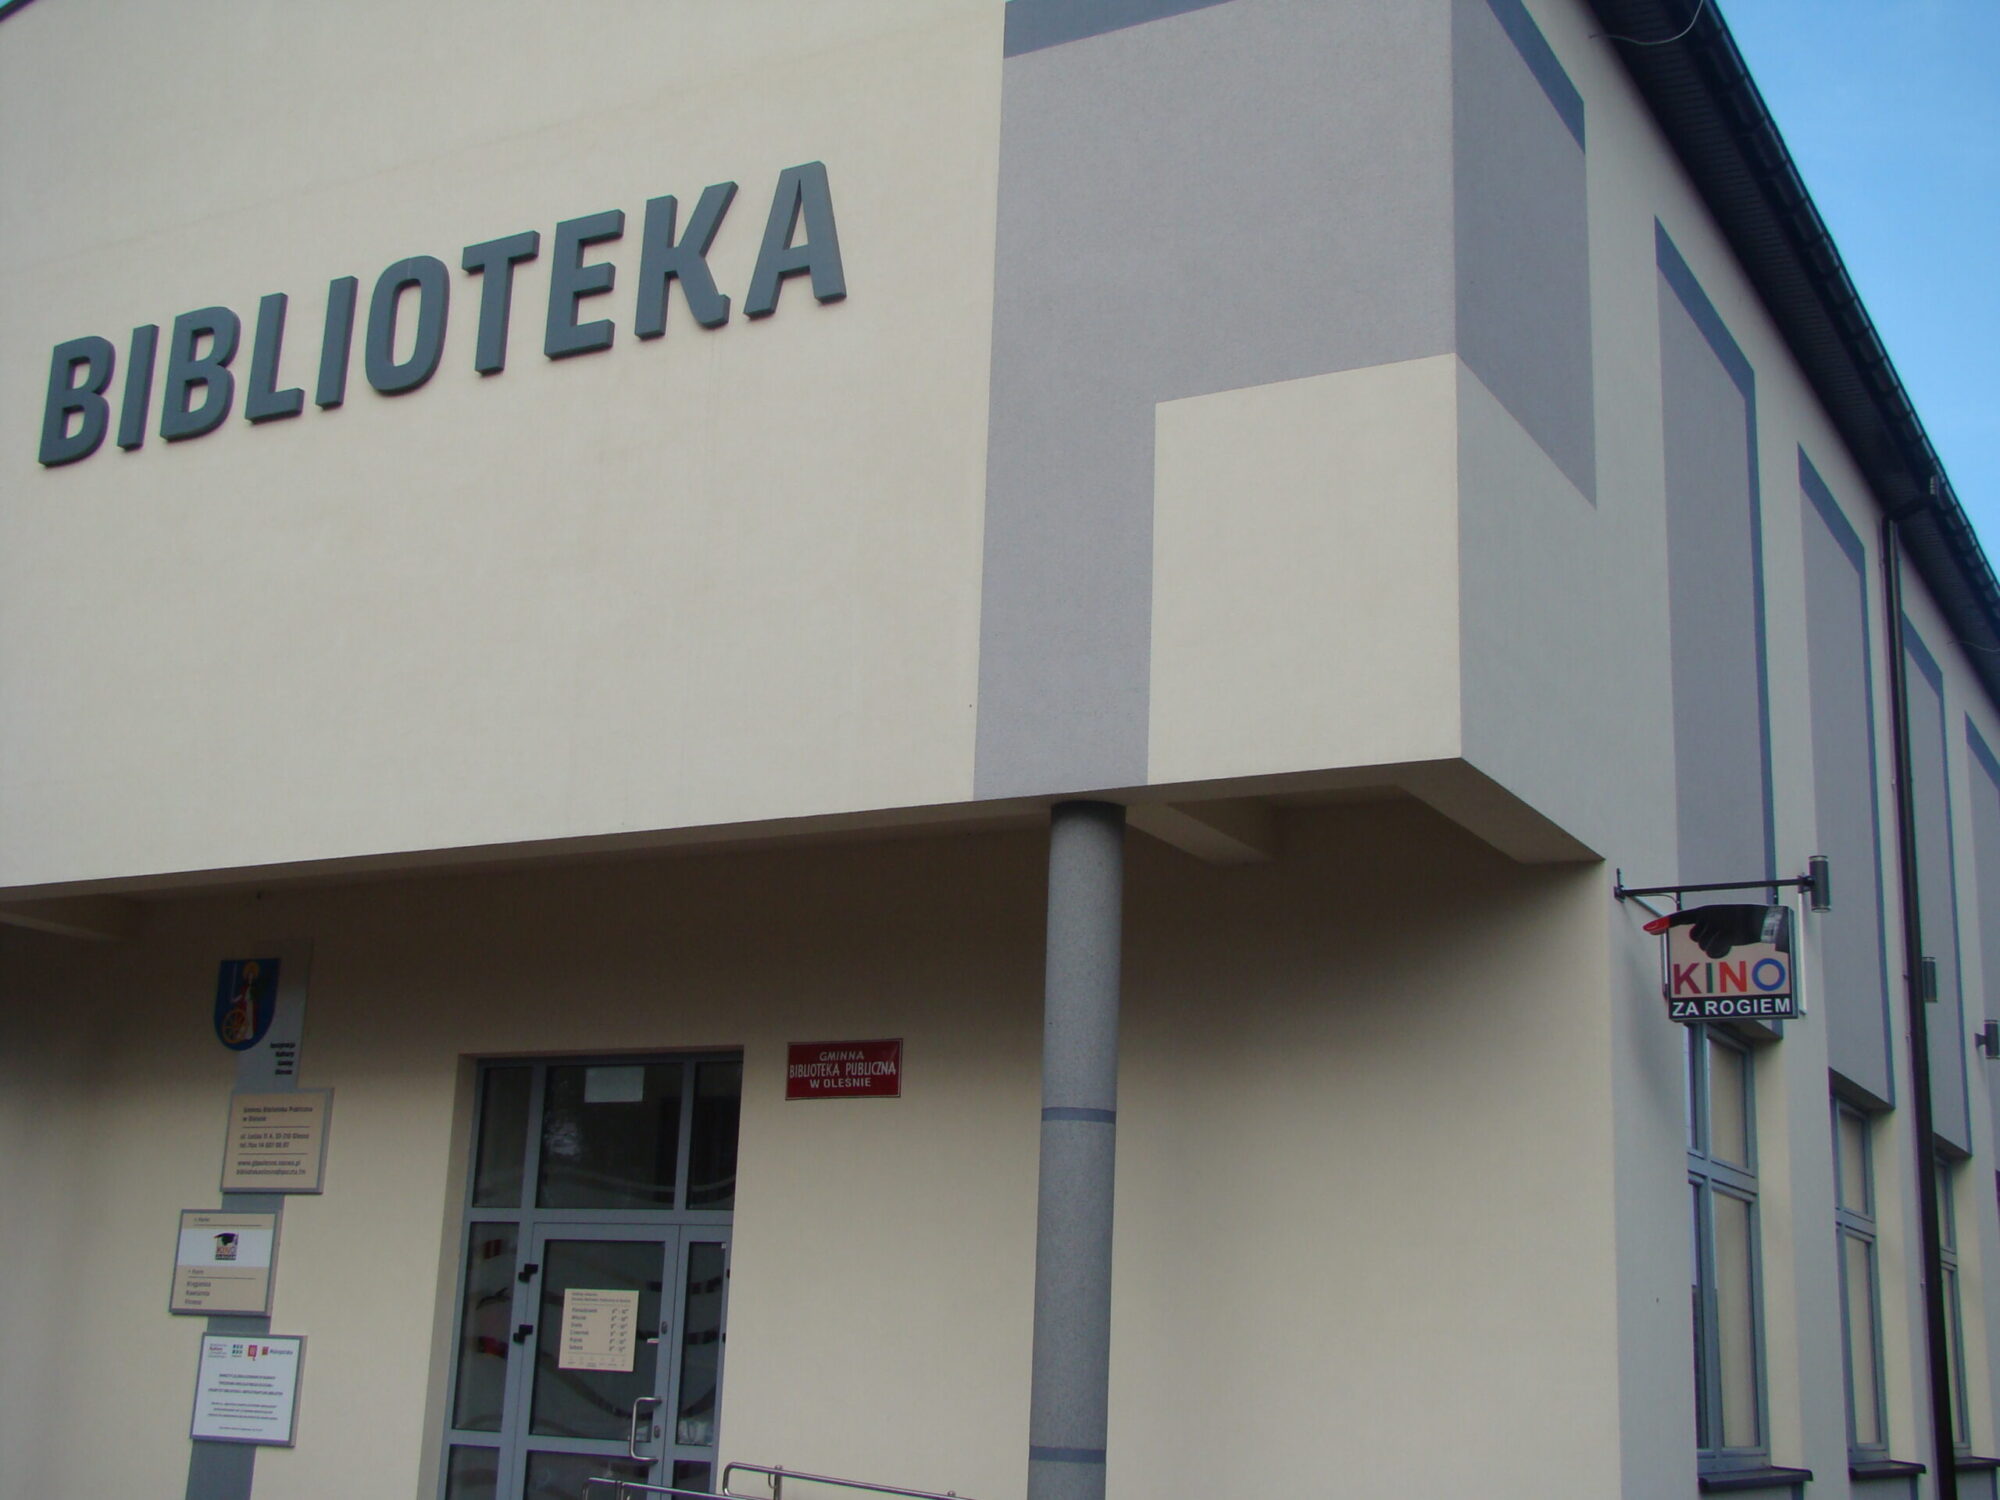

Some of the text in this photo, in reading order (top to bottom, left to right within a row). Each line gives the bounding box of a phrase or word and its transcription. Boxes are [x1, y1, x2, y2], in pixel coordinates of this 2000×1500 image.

[38, 160, 847, 467] BIBLIOTEKA
[1673, 958, 1786, 995] KINO
[1672, 998, 1791, 1016] ZA ROGIEM
[819, 1051, 864, 1061] GMINNA
[789, 1061, 896, 1078] BIBLIOTEKA PUBLICZNA
[809, 1077, 871, 1088] W OLEŚNIE
